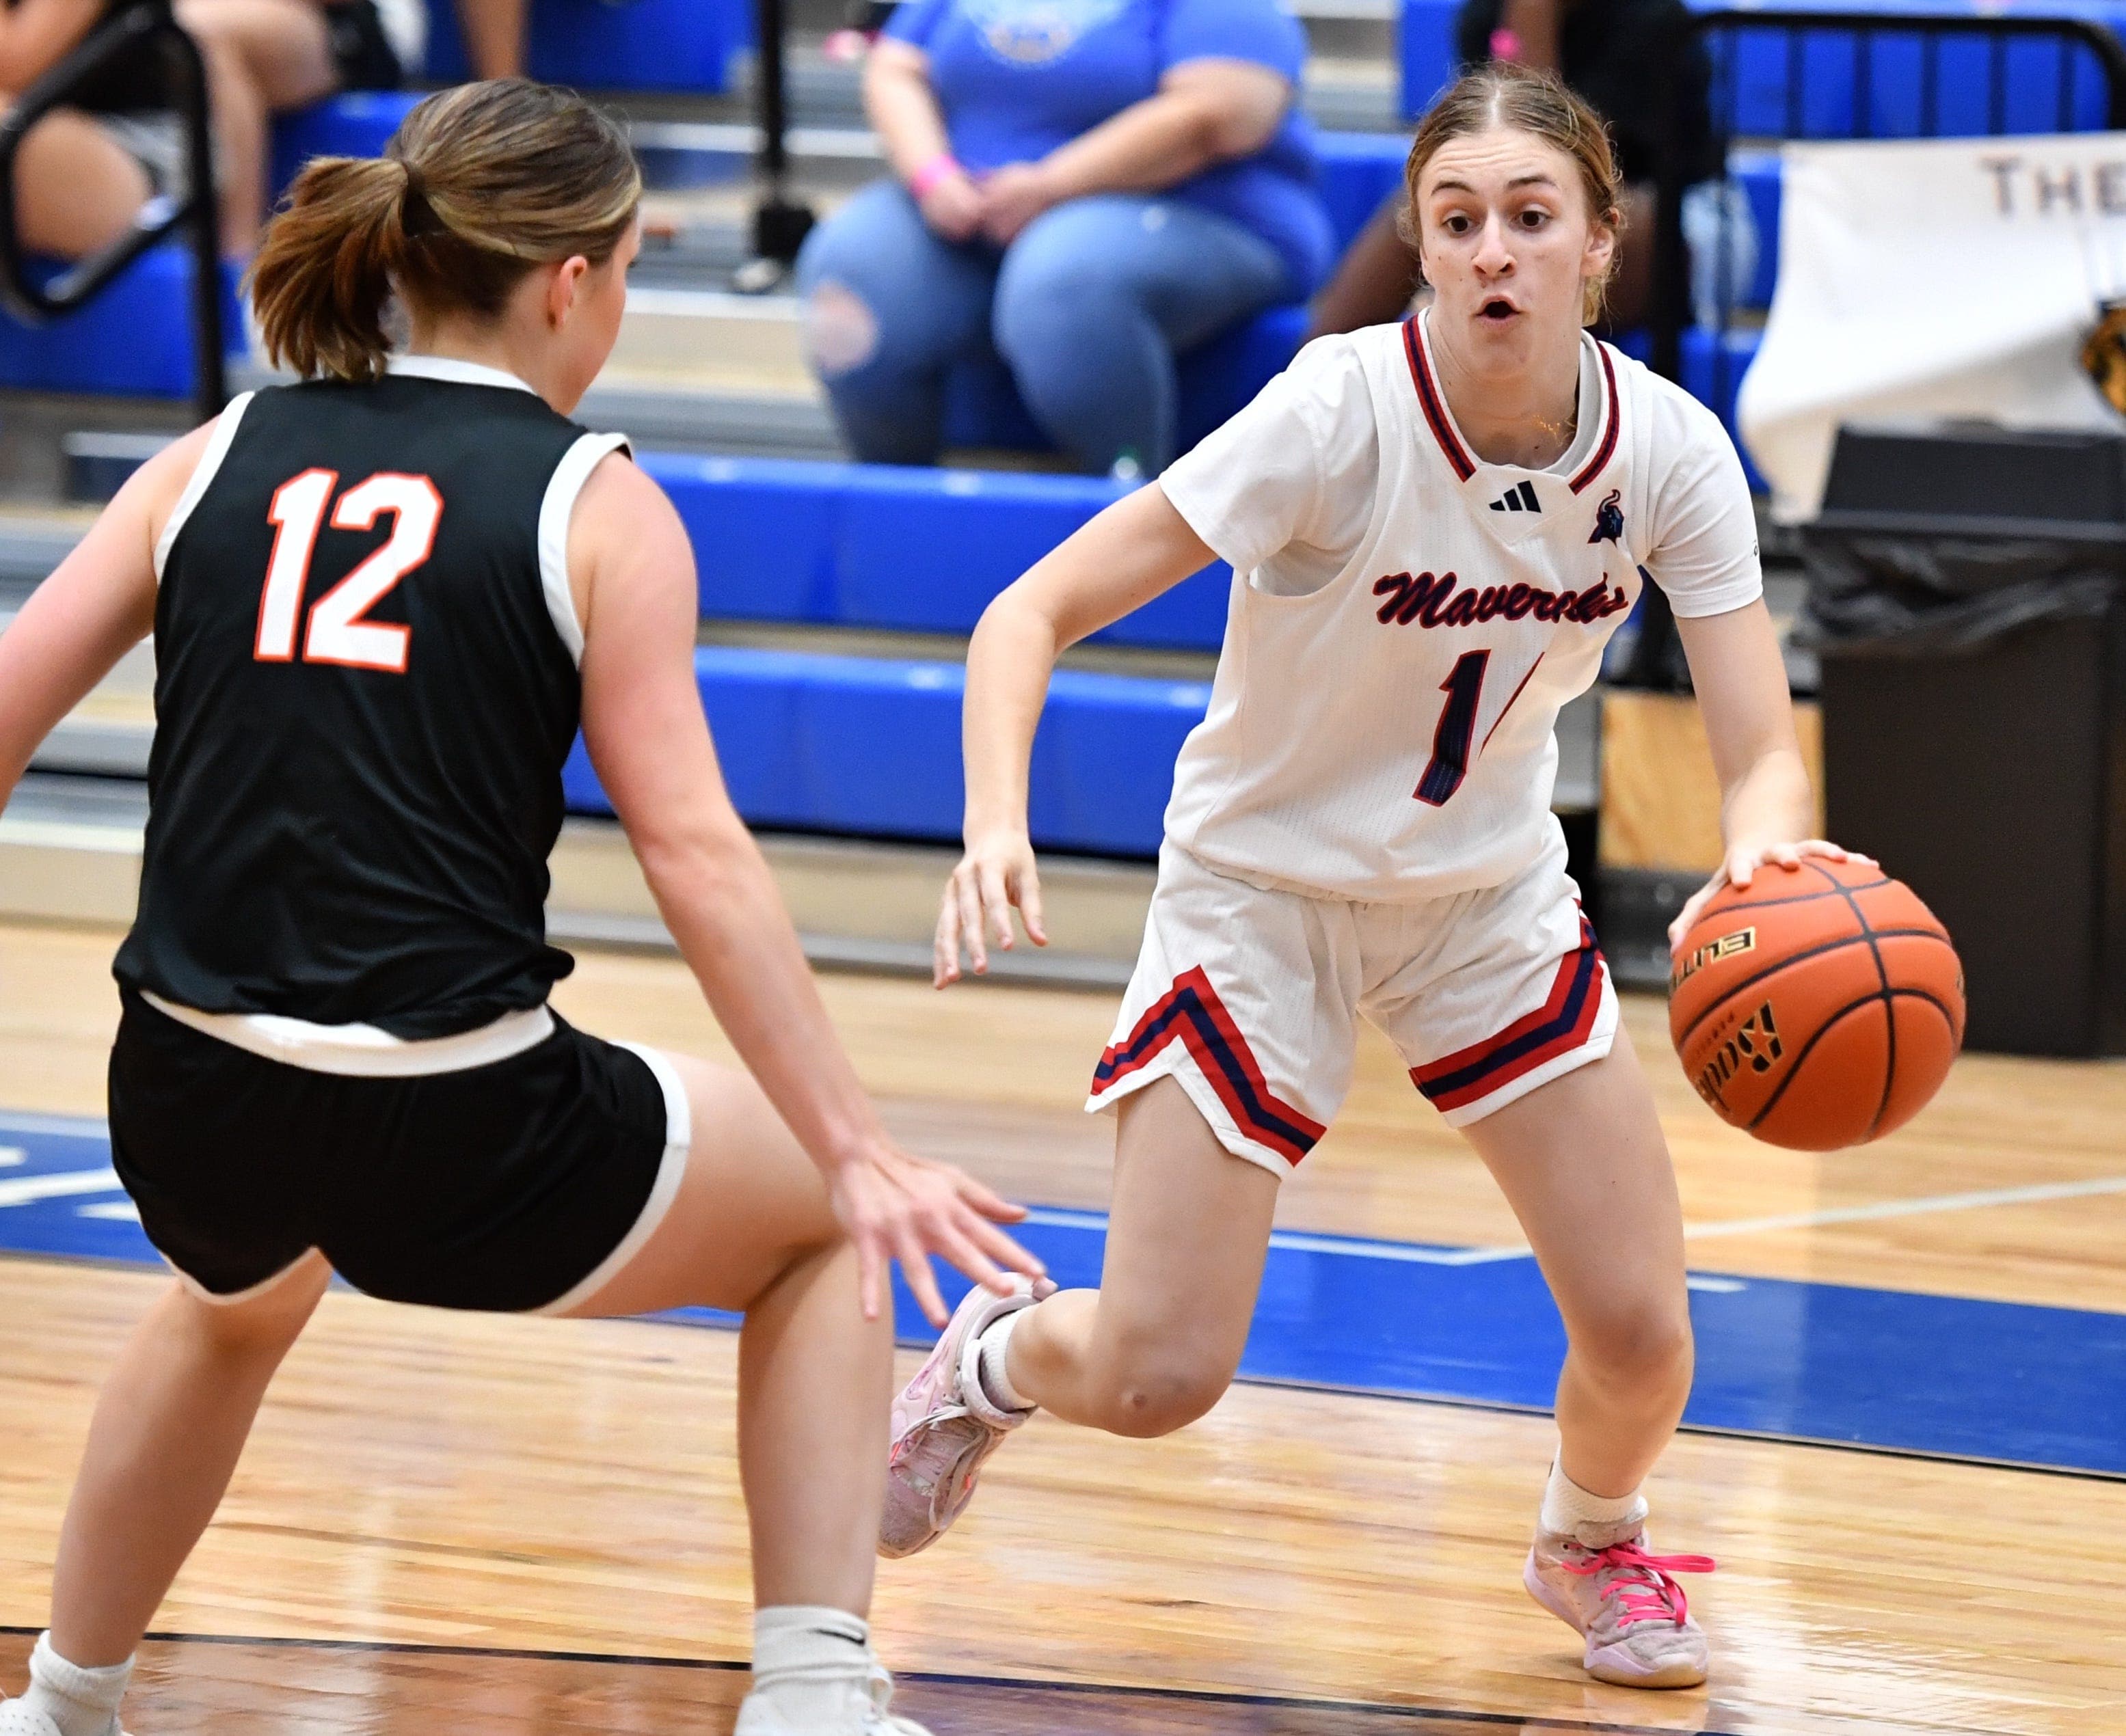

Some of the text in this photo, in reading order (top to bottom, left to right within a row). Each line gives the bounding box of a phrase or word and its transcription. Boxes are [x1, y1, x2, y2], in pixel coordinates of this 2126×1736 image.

[1978, 152, 2126, 219] THE
[253, 467, 444, 675] 12
[1412, 648, 1545, 807] 1
